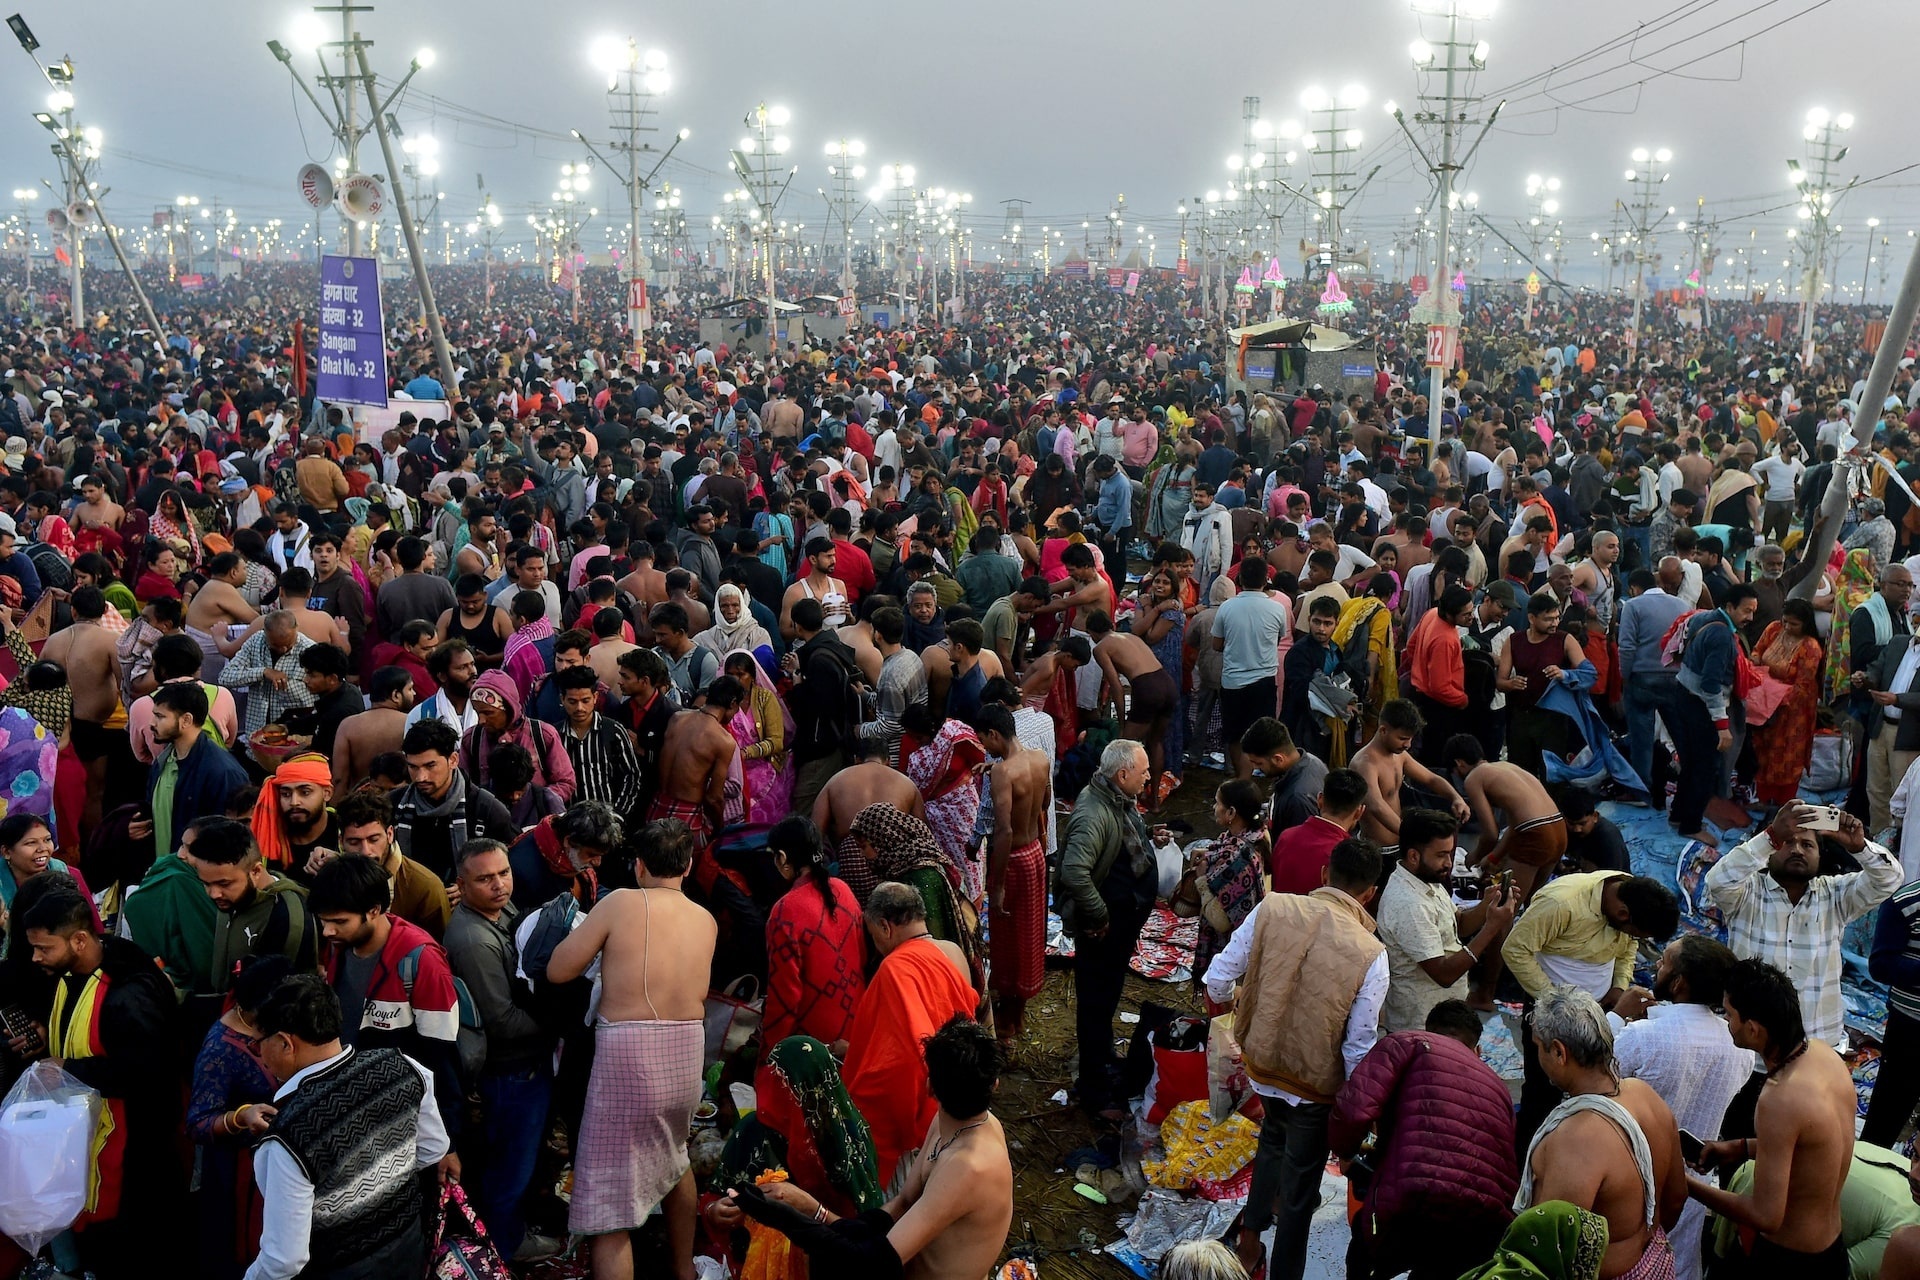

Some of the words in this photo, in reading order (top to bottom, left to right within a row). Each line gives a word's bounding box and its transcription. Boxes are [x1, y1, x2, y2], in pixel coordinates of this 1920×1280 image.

[323, 280, 343, 302] संगम
[344, 285, 358, 303] घाट
[322, 303, 346, 326] संख्या
[353, 309, 363, 327] 32
[838, 298, 855, 314] 149
[322, 331, 356, 354] Sangam
[321, 355, 342, 375] Ghat
[363, 360, 375, 379] 32
[364, 1001, 402, 1021] Royal
